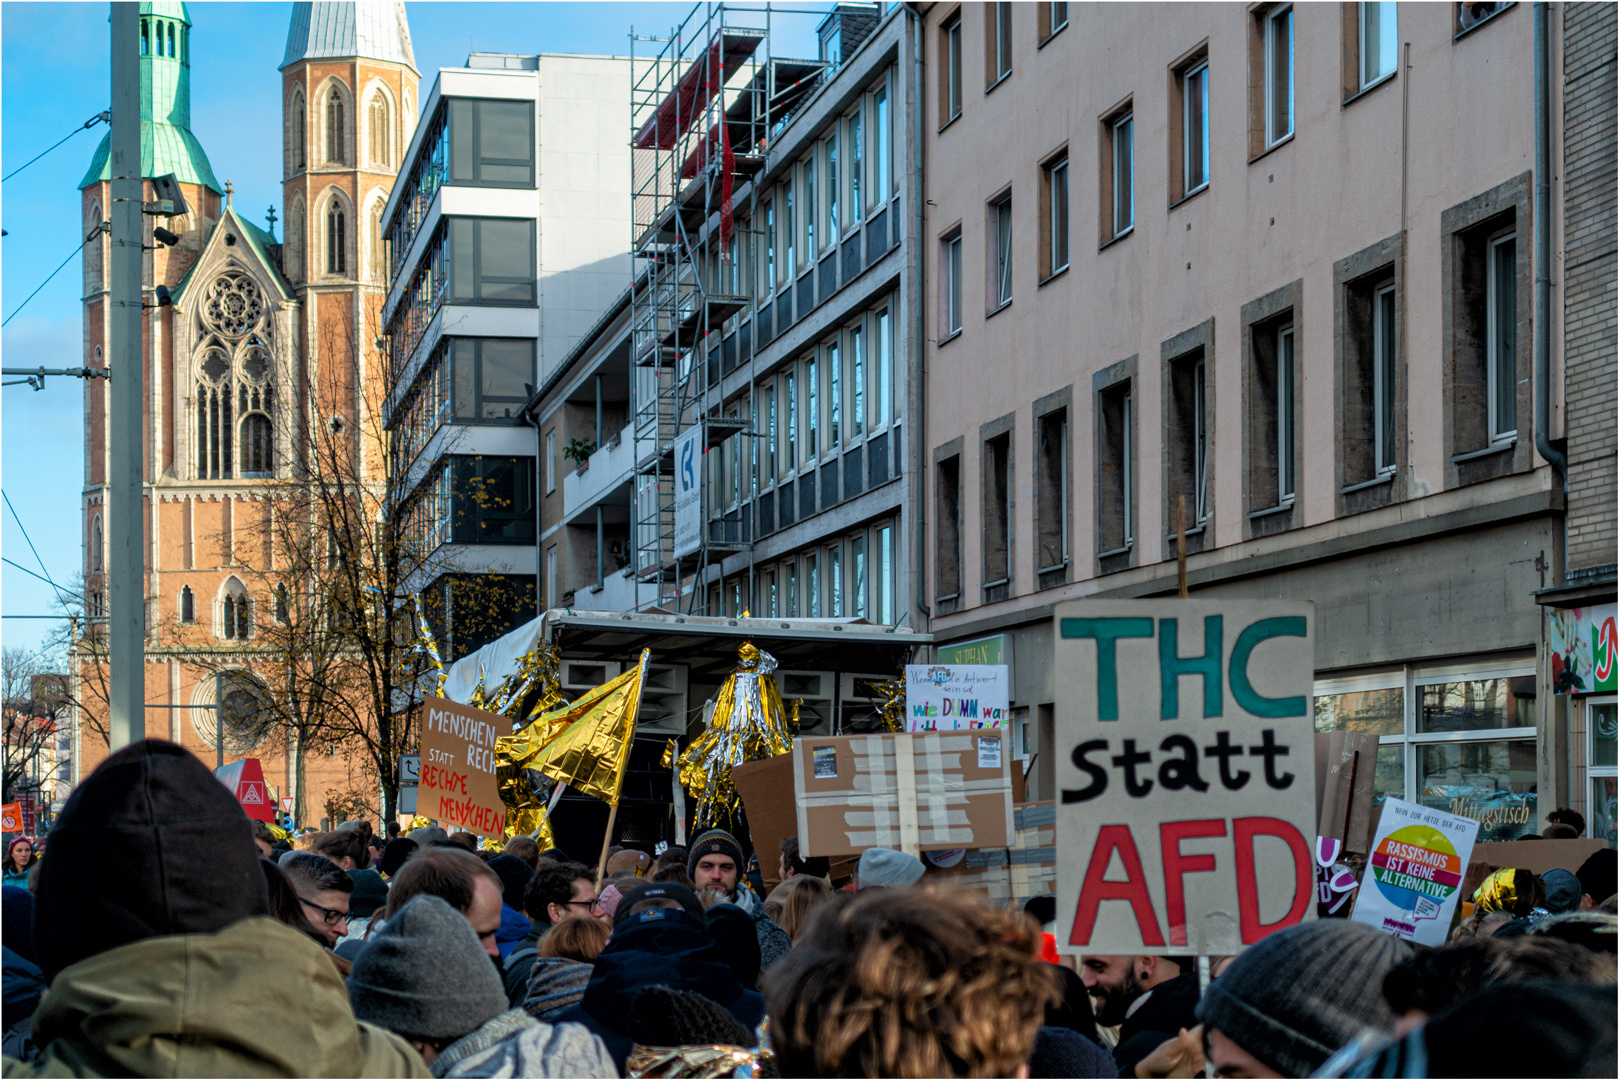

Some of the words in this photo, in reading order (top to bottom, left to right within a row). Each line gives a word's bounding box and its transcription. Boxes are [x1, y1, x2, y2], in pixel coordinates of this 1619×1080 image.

[931, 671, 948, 683] AFD
[1060, 614, 1308, 721] THC
[913, 701, 938, 718] wie
[943, 697, 978, 719] DUMM
[983, 707, 1009, 720] war
[428, 707, 496, 748] MENSCHEN
[428, 748, 455, 767] STATT
[1061, 729, 1296, 805] statt
[422, 764, 468, 796] RECHTE
[439, 795, 505, 836] MENSCHEN
[1394, 807, 1408, 816] NEIN
[1410, 811, 1421, 820] ZUR
[1424, 815, 1440, 826] HETZE
[1441, 820, 1454, 829] DER
[1455, 823, 1467, 833] AFD
[1448, 797, 1530, 832] Mittagstisch
[1386, 840, 1449, 869] RASSISMUS
[1386, 856, 1405, 872] IST
[1406, 862, 1437, 881] KEINE
[1068, 816, 1314, 947] AFD
[1379, 869, 1449, 899] ALTERNATIVE
